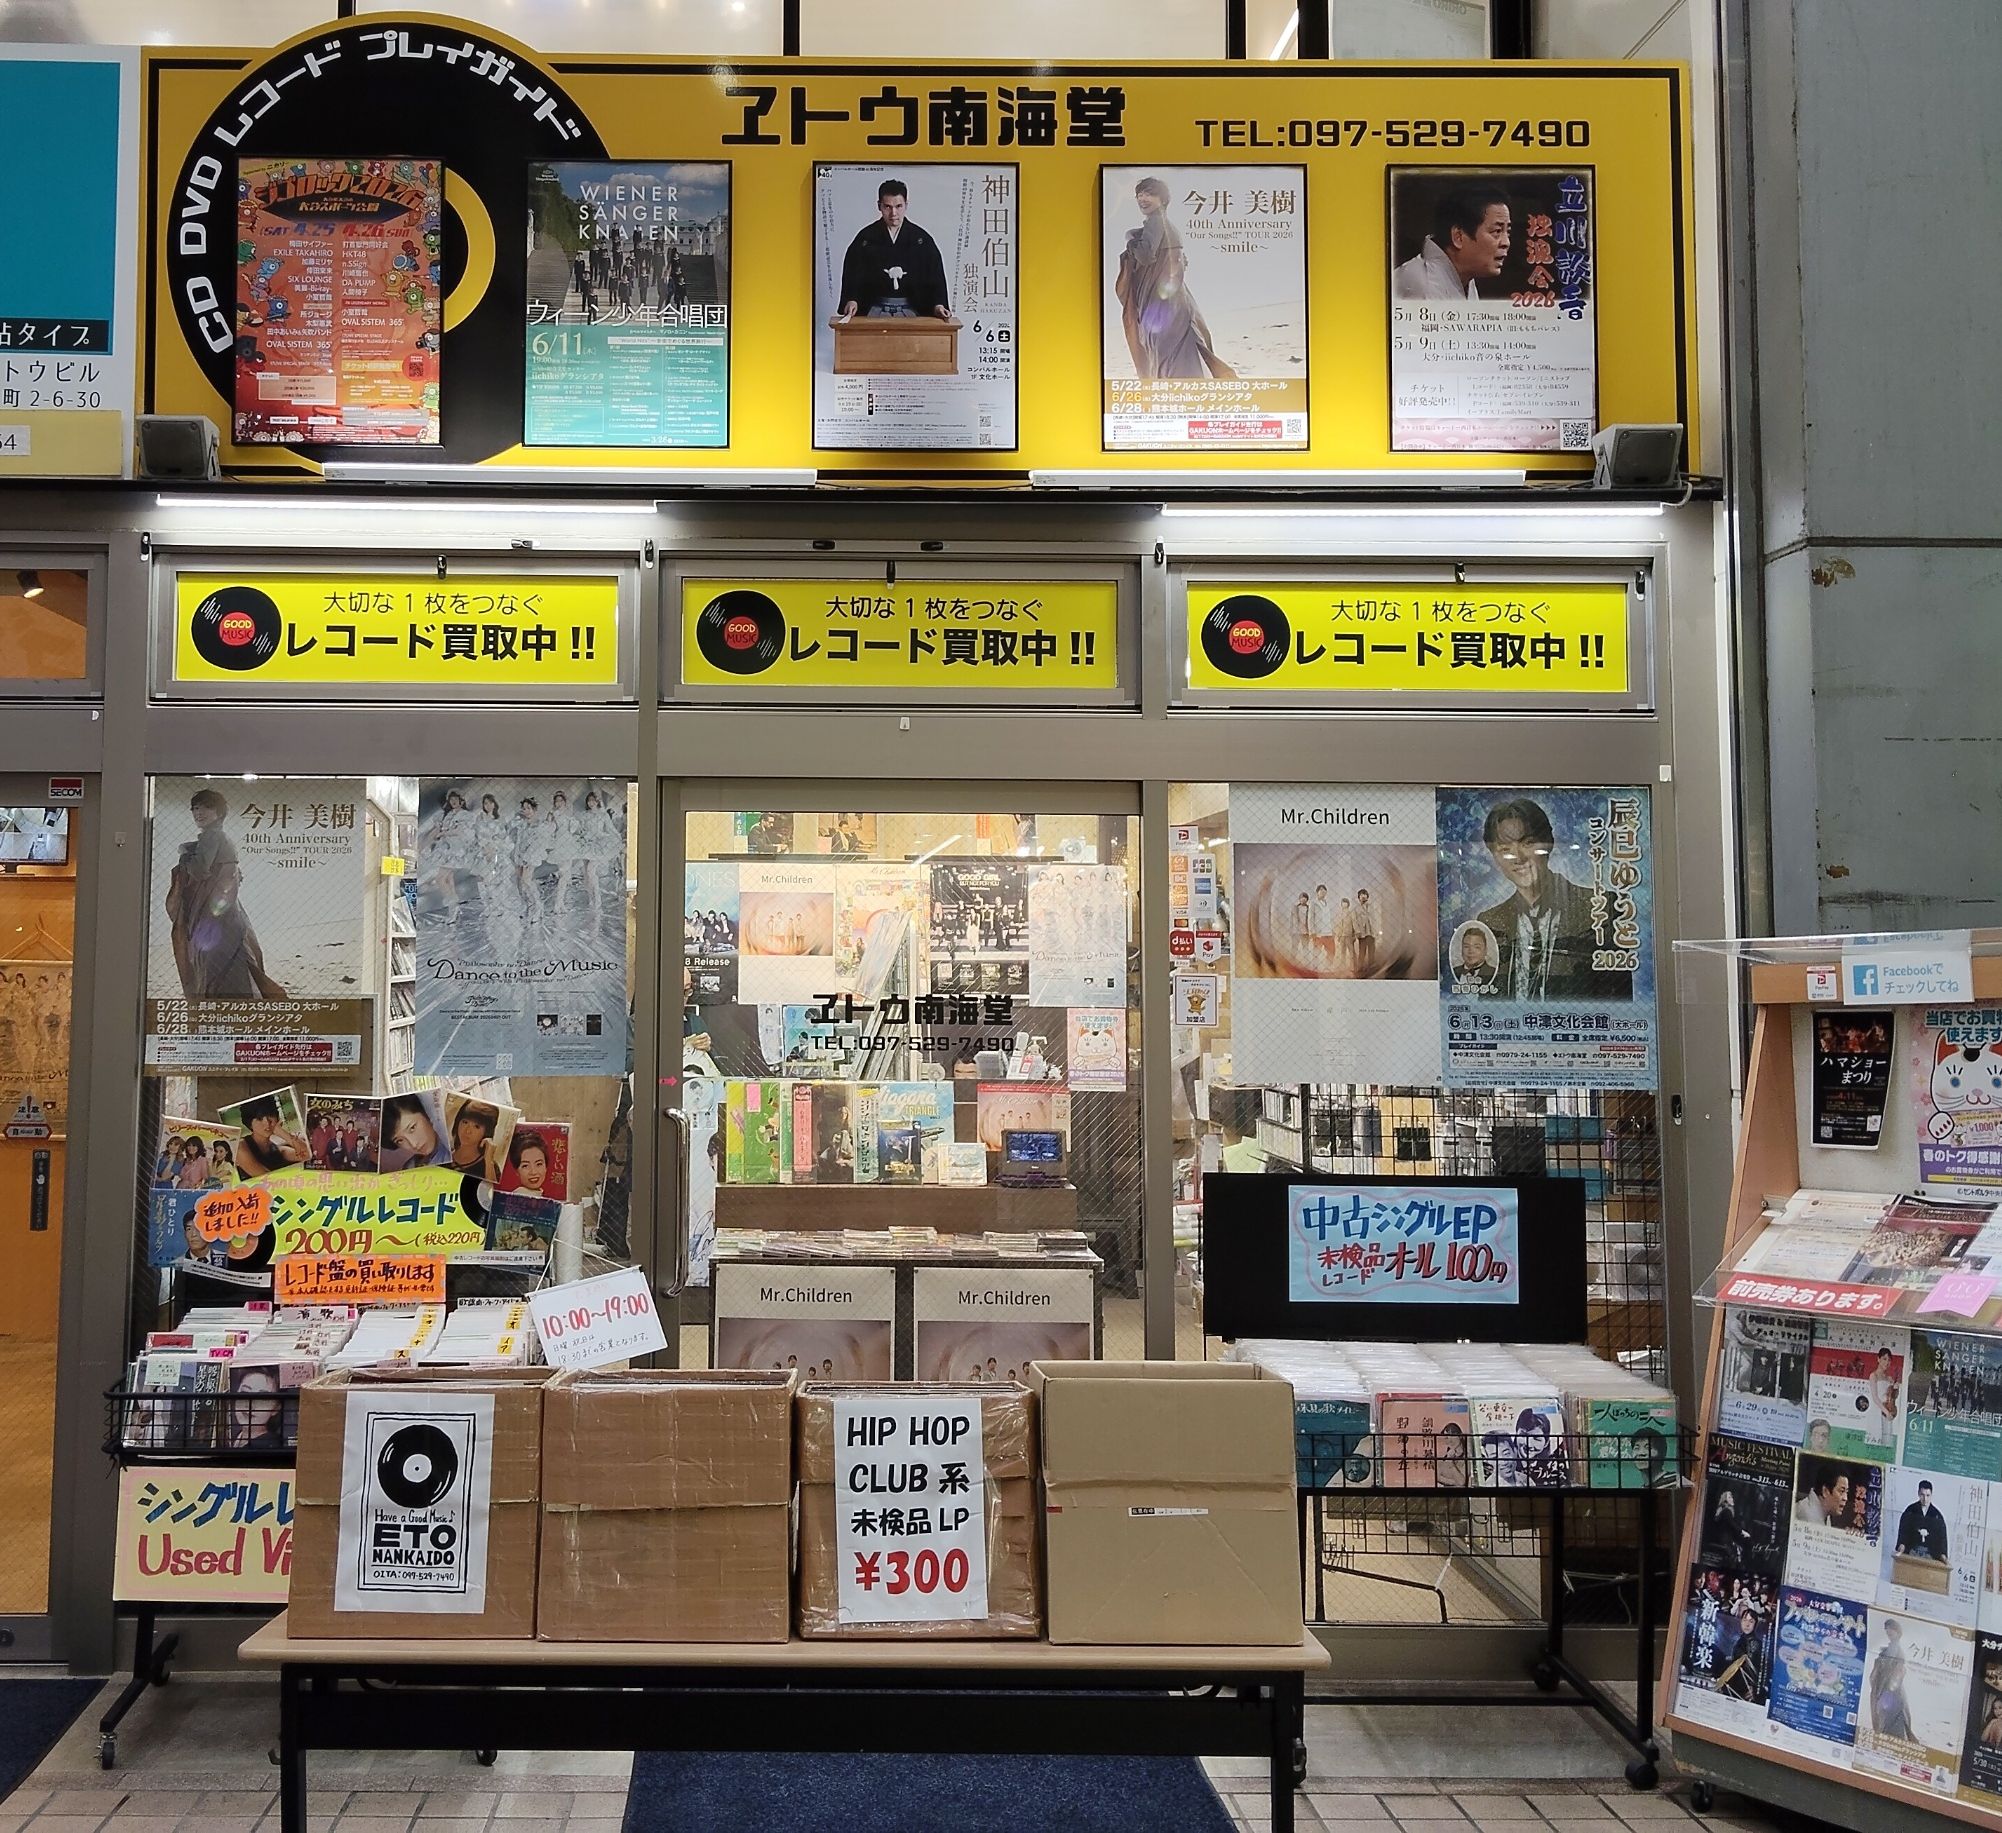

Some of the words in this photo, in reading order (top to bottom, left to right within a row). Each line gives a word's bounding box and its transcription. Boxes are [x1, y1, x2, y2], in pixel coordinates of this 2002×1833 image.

[213, 39, 343, 147] レコード
[360, 28, 582, 142] プレイガイド
[1196, 118, 1591, 148] TEL:097-529-7490
[580, 185, 678, 202] WIENER
[179, 155, 223, 255] DVD
[1183, 190, 1233, 215] 今井
[1245, 190, 1296, 215] 美樹
[579, 202, 678, 221] SÄNGER
[294, 223, 335, 236] 4.25
[343, 224, 383, 238] 4.26
[1186, 219, 1213, 229] 40th
[1218, 219, 1292, 230] Anniversary
[982, 175, 1010, 298] 神田伯山
[1554, 175, 1591, 320] 立川談春
[963, 262, 979, 313] 独演会
[1510, 291, 1555, 308] 2026
[195, 276, 234, 354] CD
[527, 299, 727, 328] ウィーン少年合唱団
[1394, 308, 1412, 321] 5月
[532, 332, 582, 356] 6/11
[1394, 336, 1412, 350] 5月
[1111, 381, 1142, 391] 5/22
[1252, 382, 1287, 390] 大ホール
[1410, 384, 1445, 392] チケット
[30, 391, 100, 407] 2-6-30
[1112, 393, 1142, 402] 6/26
[1151, 393, 1252, 402] 大分iichikoグランシアタ
[1112, 403, 1142, 413] 6/28
[1207, 404, 1260, 412] メインホール
[223, 619, 253, 630] GOOD
[728, 623, 756, 634] GOOD
[1232, 627, 1261, 638] GOOD
[221, 629, 255, 640] MUSIC
[726, 633, 758, 644] MUSIC
[1230, 636, 1264, 648] MUSIC
[240, 803, 293, 829] 今井
[304, 803, 357, 829] 美樹
[1281, 808, 1389, 825] Mr.Children
[243, 833, 271, 843] 40th
[275, 833, 351, 845] Anniversary
[761, 875, 813, 884] Mr.Children
[1588, 816, 1608, 946] コンサートツアー
[1608, 797, 1641, 948] 辰巳ゆうと
[428, 958, 500, 979] Dance
[503, 970, 517, 979] to
[519, 968, 541, 978] the
[544, 959, 618, 976] Music
[694, 957, 730, 966] Release
[1592, 950, 1639, 971] 2026
[1883, 963, 1944, 976] Facebookで
[1884, 979, 1959, 993] チェックしてね
[157, 1000, 188, 1011] 5/22
[303, 1002, 339, 1011] 大ホール
[157, 1012, 188, 1023] 6/26
[198, 1013, 303, 1023] 大分iichikoグランシアタ
[1523, 1014, 1609, 1031] 中津文化会館
[157, 1023, 188, 1034] 6/28
[255, 1026, 310, 1034] メインホール
[811, 1035, 1014, 1051] TEL:097-529-7490
[1820, 1056, 1887, 1067] ハマショー
[1841, 1071, 1872, 1084] まつり
[310, 1098, 353, 1110] 女のみち
[904, 1105, 940, 1116] TRIANGLE
[551, 1138, 566, 1185] 悲しい酒
[269, 1191, 460, 1227] シングルレコード
[1302, 1194, 1497, 1244] 中古シングルEP
[1317, 1242, 1385, 1269] 未検品
[1323, 1268, 1375, 1287] レコード
[760, 1287, 852, 1303] Mr.Children
[958, 1290, 1050, 1307] Mr.Children
[1727, 1280, 1884, 1311] 前売券あります。
[1937, 1337, 1985, 1353] WIENER
[847, 1416, 897, 1447] HIP
[909, 1415, 971, 1446] HOP
[1711, 1436, 1745, 1450] MUSIC
[1747, 1443, 1791, 1460] FESTIVAL
[849, 1463, 928, 1494] CLUB
[939, 1462, 971, 1495] 系
[375, 1509, 397, 1523] Have
[401, 1514, 406, 1523] a
[409, 1510, 427, 1523] Good
[430, 1511, 448, 1523] Music
[850, 1508, 932, 1537] 未検品
[939, 1508, 970, 1532] LP
[373, 1524, 457, 1549] ETO
[138, 1526, 247, 1576] Used
[372, 1549, 454, 1566] NANKAIDO
[854, 1548, 970, 1594] ¥300
[1908, 1642, 1933, 1660] 今井
[1941, 1649, 1965, 1671] 美樹
